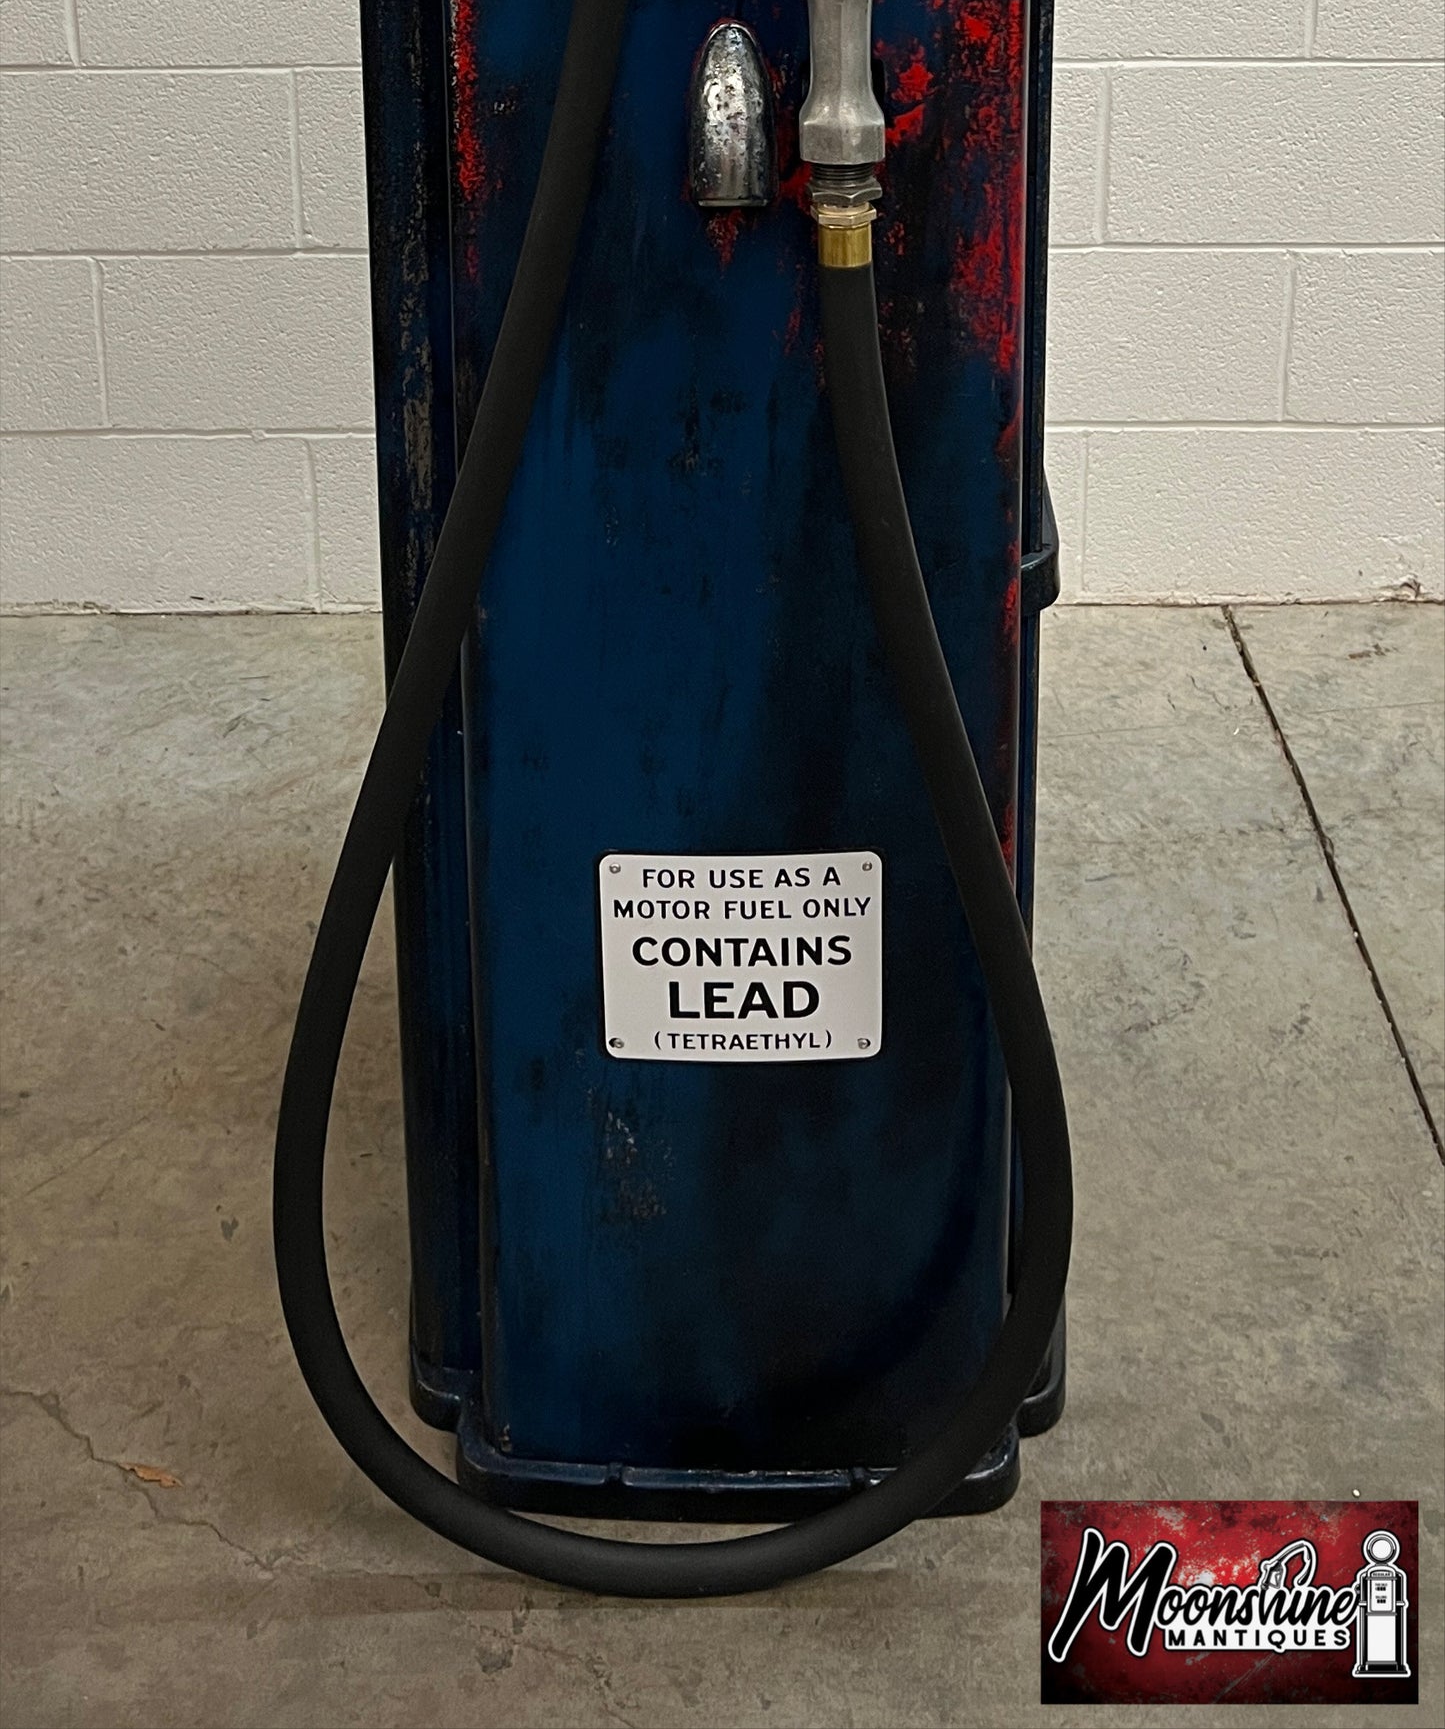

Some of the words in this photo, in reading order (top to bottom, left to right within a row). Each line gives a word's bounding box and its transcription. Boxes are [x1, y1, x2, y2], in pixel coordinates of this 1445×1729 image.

[642, 869, 695, 889] FOR
[709, 869, 763, 888] USE
[774, 868, 810, 887] AS
[822, 867, 841, 886] A
[613, 900, 710, 919] MOTOR
[724, 900, 792, 919] FUEL
[803, 897, 871, 918] ONLY
[632, 936, 851, 967] CONTAINS
[669, 981, 820, 1019] LEAD
